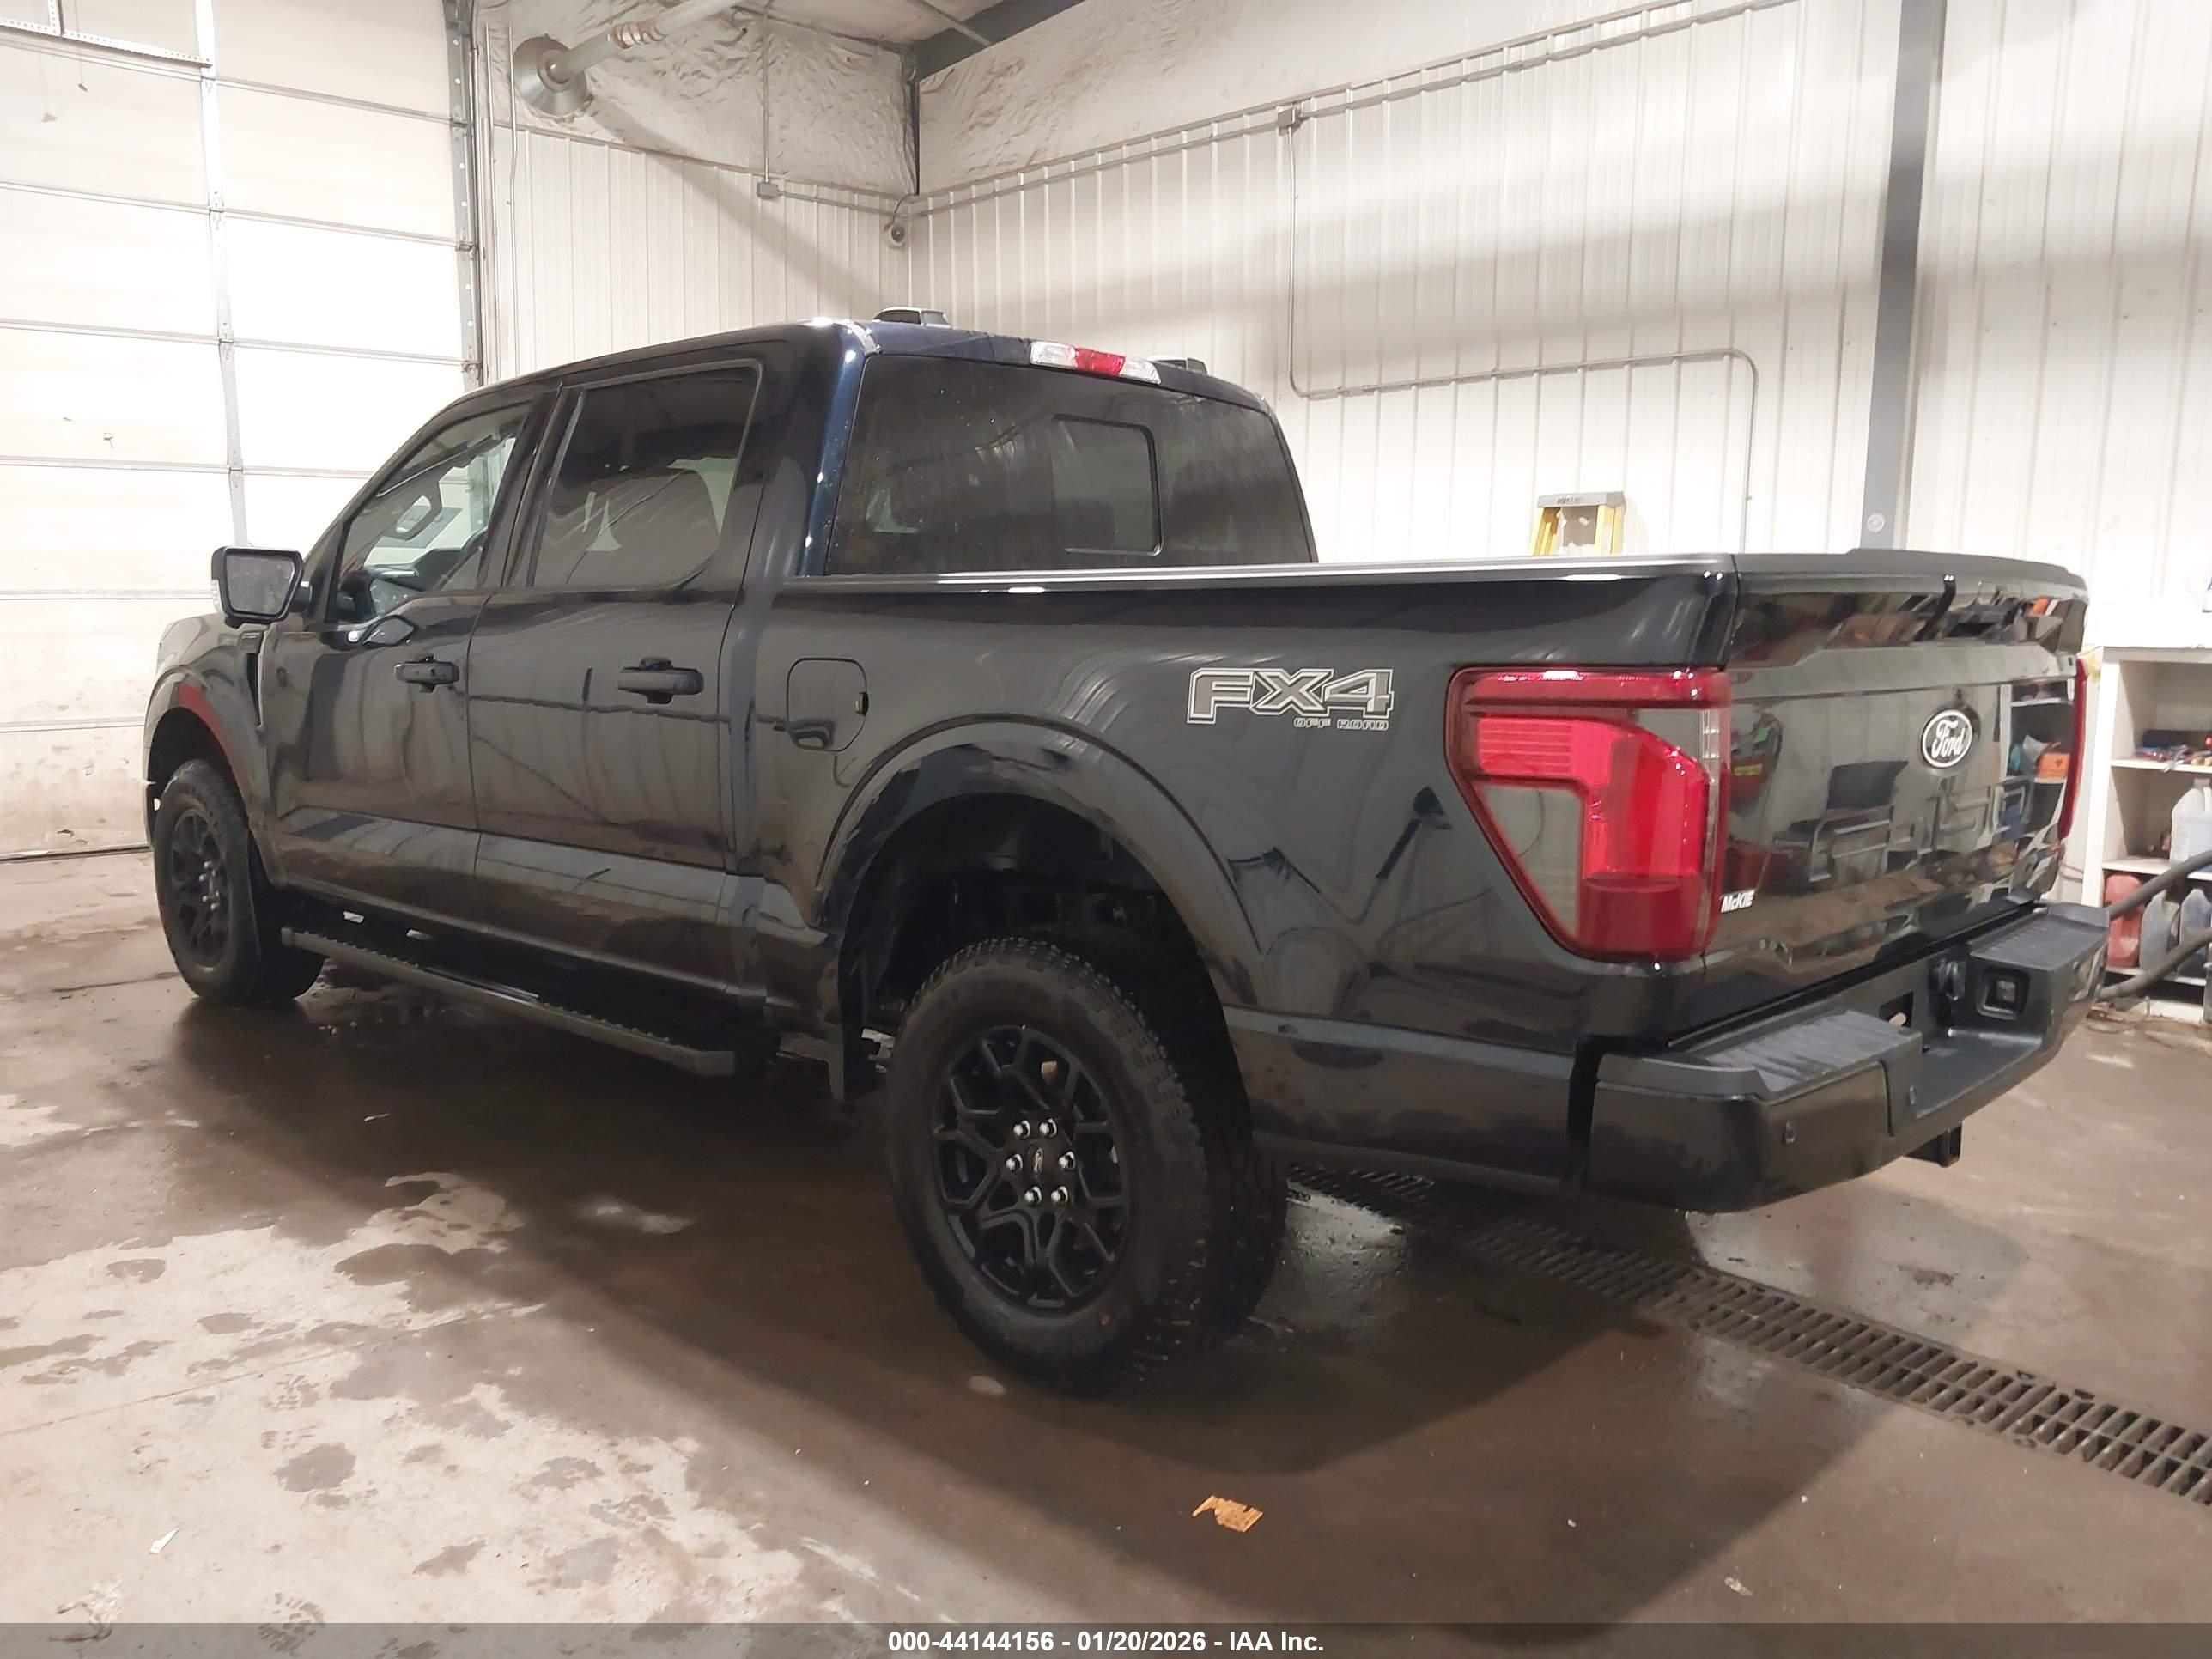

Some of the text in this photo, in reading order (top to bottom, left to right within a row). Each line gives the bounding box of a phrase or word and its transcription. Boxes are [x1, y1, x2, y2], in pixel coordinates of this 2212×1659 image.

[1187, 668, 1395, 724] FX4
[1293, 717, 1389, 731] OFF ROAD
[1930, 719, 1966, 759] Ford
